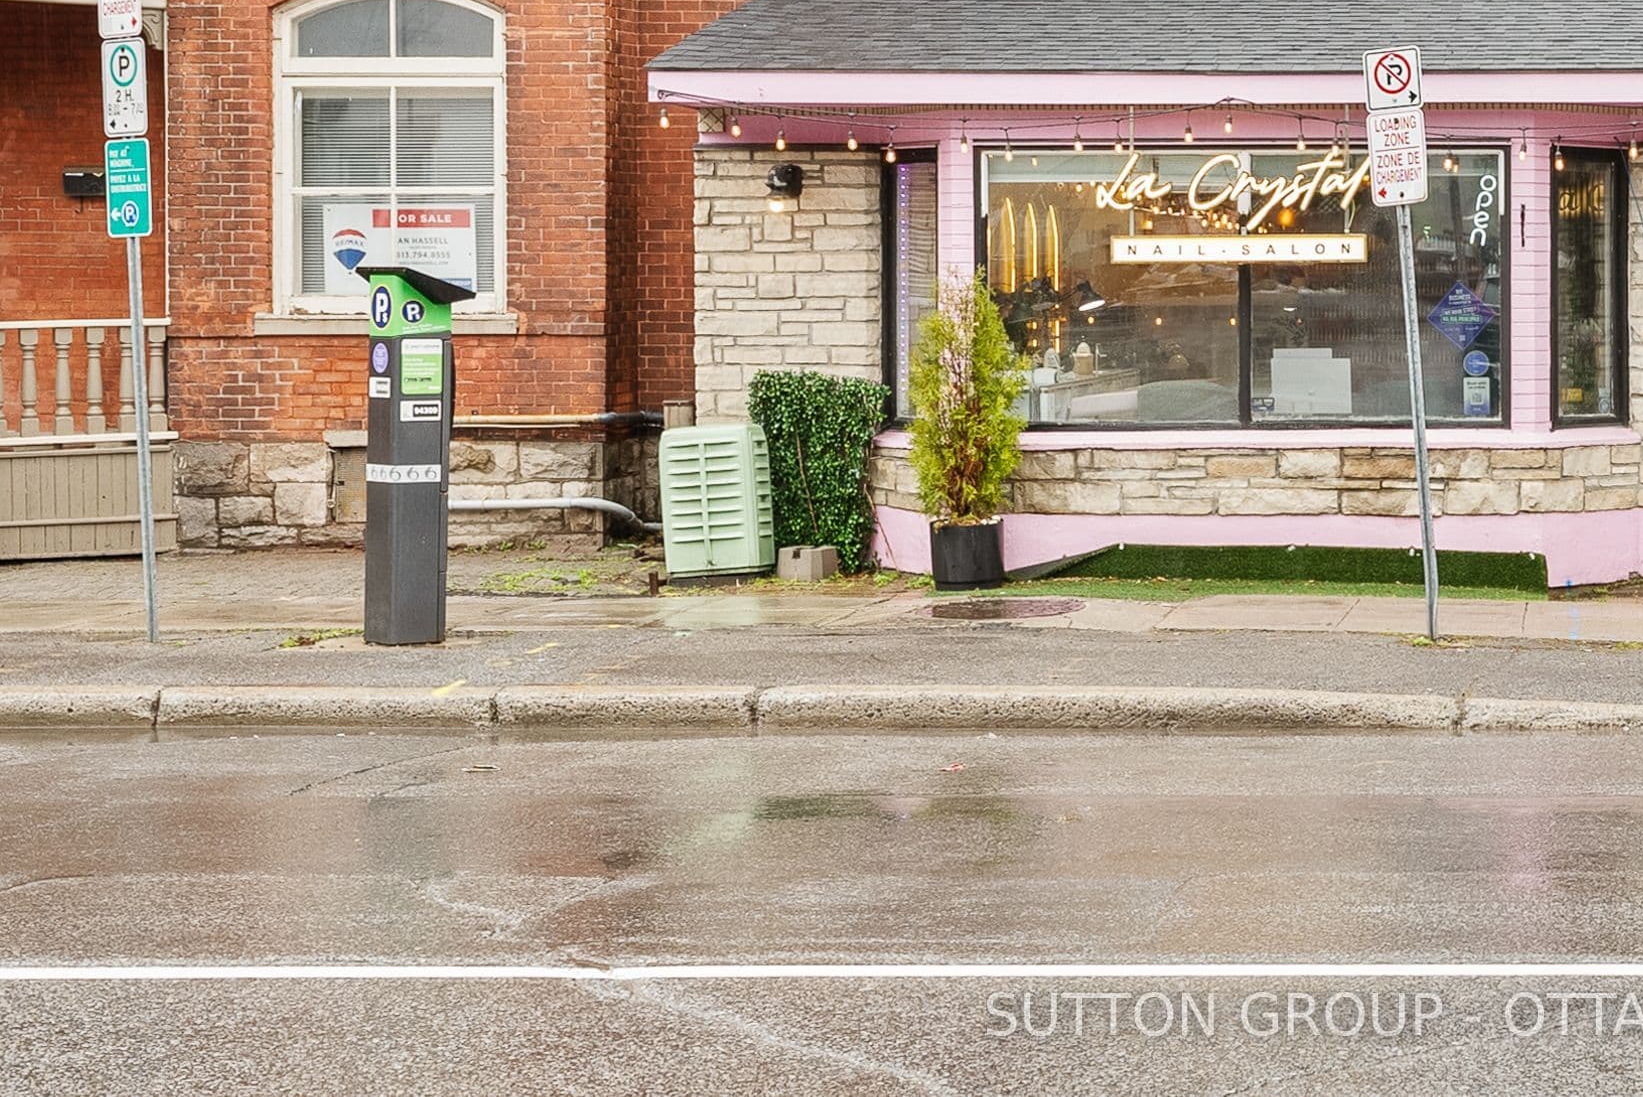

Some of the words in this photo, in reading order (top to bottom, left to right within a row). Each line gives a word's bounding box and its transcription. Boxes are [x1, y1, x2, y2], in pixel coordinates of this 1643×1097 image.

[1375, 116, 1416, 132] LOADING
[1384, 132, 1410, 147] ZONE
[1377, 153, 1403, 168] ZONE
[1408, 152, 1420, 165] DE
[1095, 152, 1172, 210] La
[1188, 151, 1371, 231] Crystal
[420, 214, 451, 223] SALE
[1127, 244, 1206, 255] NAIL
[1241, 243, 1352, 255] SALON
